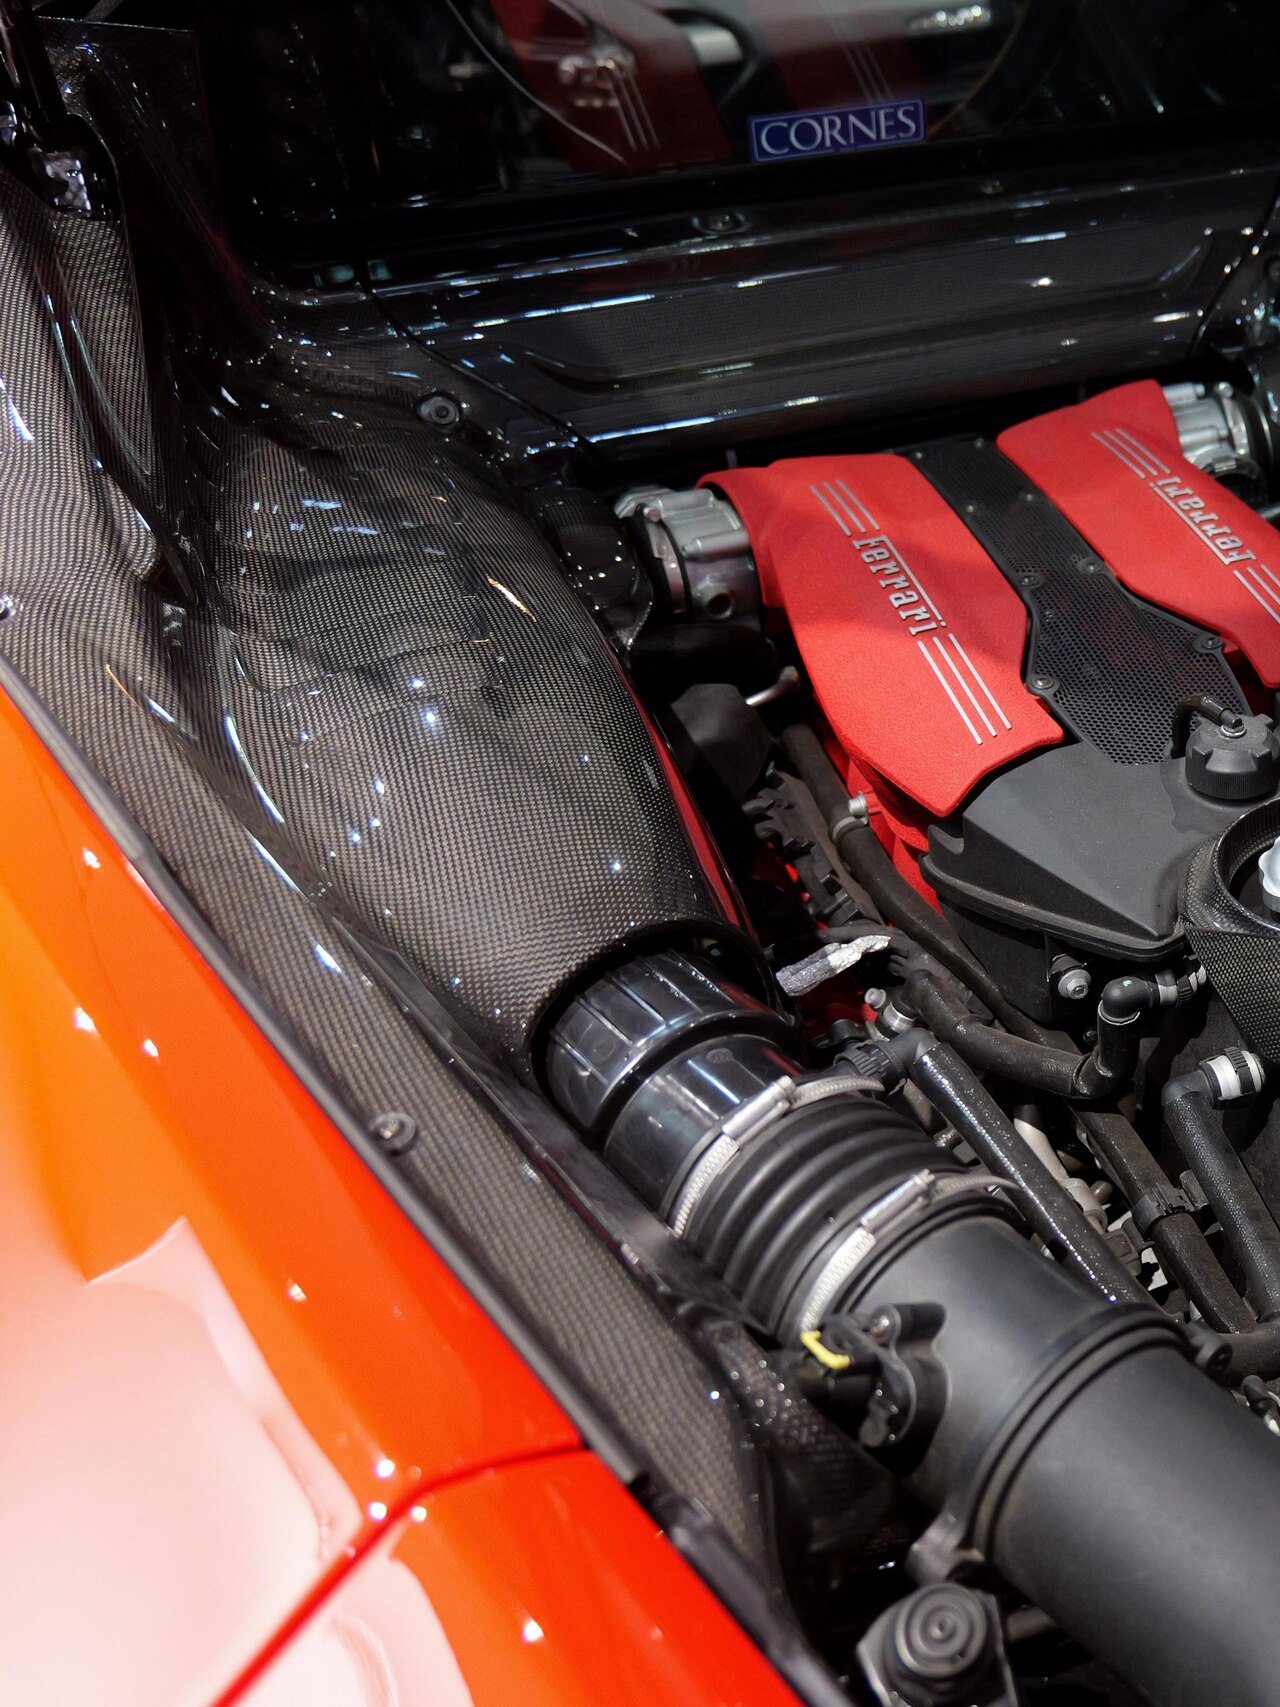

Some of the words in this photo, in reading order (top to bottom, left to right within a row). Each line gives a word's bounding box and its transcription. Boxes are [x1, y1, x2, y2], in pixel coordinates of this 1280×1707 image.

[760, 105, 917, 155] CORNES
[1149, 476, 1257, 565] Ferrari
[852, 535, 947, 635] Ferrari
